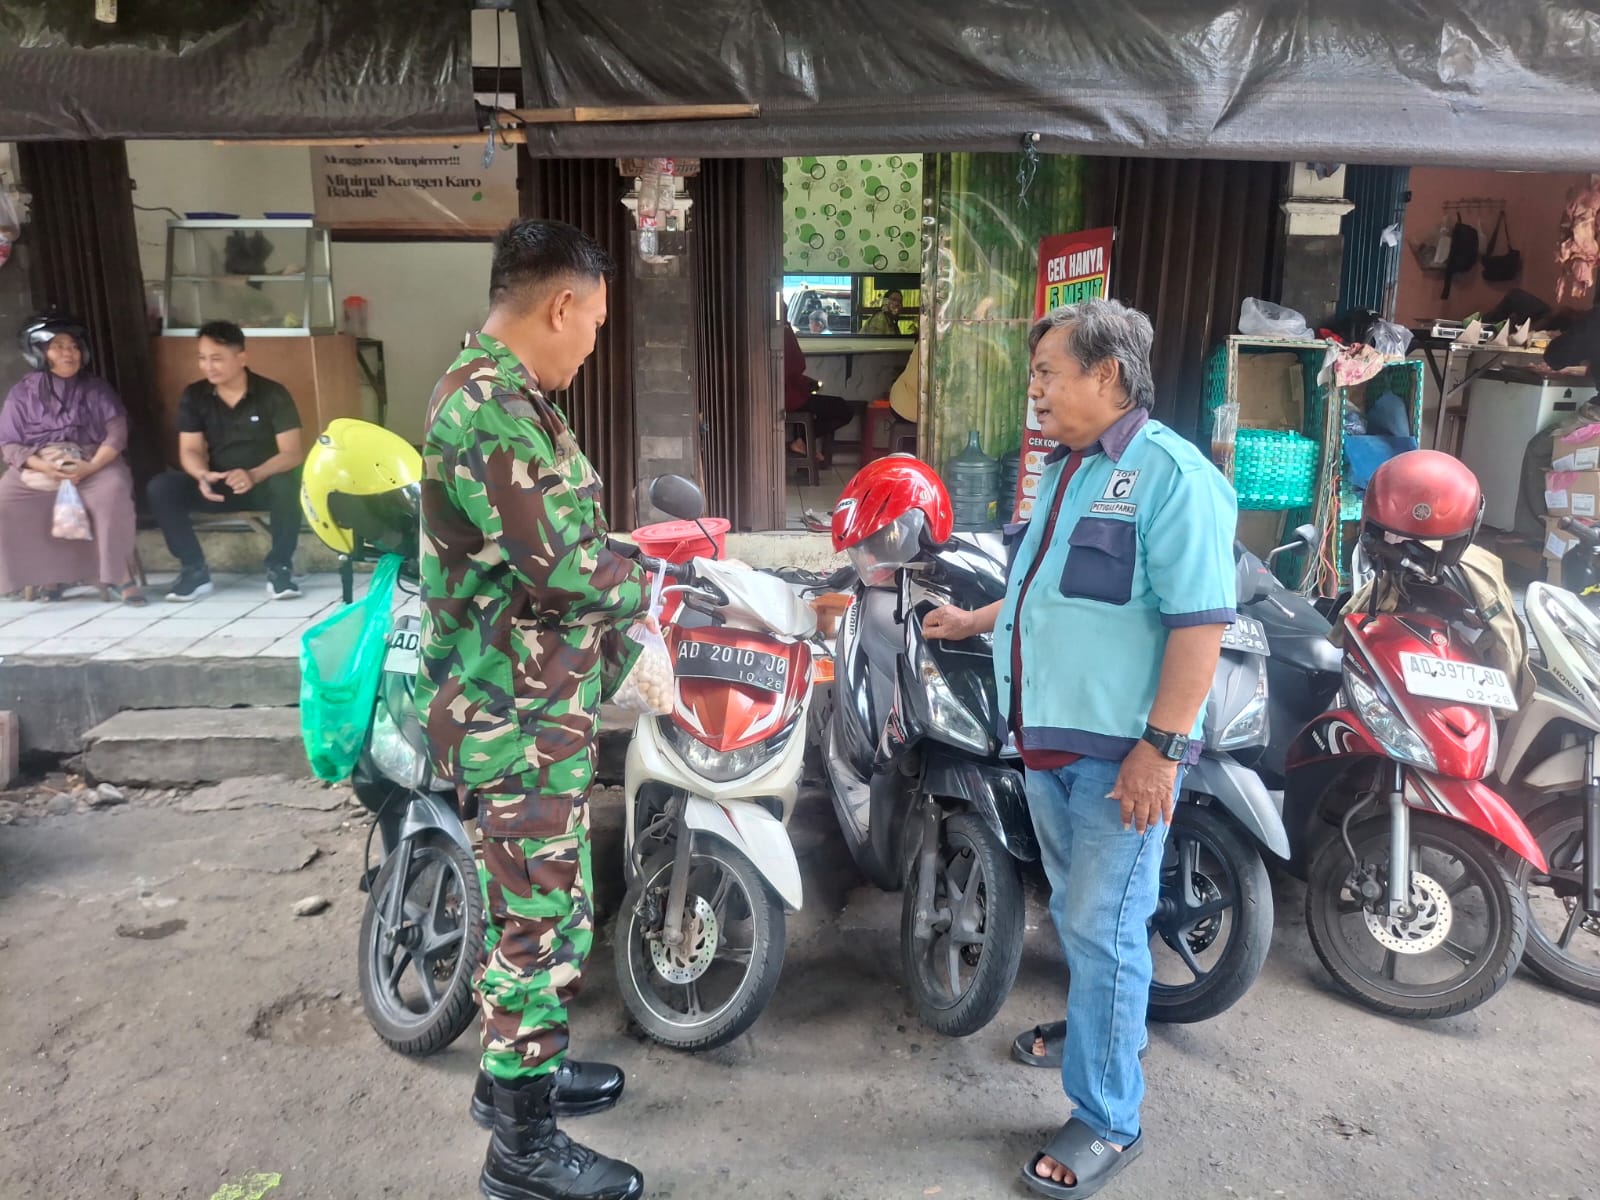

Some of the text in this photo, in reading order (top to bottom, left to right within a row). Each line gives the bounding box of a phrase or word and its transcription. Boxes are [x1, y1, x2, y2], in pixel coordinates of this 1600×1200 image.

[326, 174, 481, 190] Minimal Kangen Karo
[327, 185, 378, 198] Bakule
[1047, 246, 1104, 282] CEK HANYA
[1049, 286, 1060, 312] 5
[1028, 437, 1044, 447] CEK
[1112, 478, 1131, 498] C
[393, 633, 419, 650] AD
[678, 642, 700, 659] AD
[710, 645, 755, 667] 2010
[1410, 655, 1432, 675] AD
[1435, 661, 1476, 683] 3977
[1552, 666, 1586, 701] HONDA
